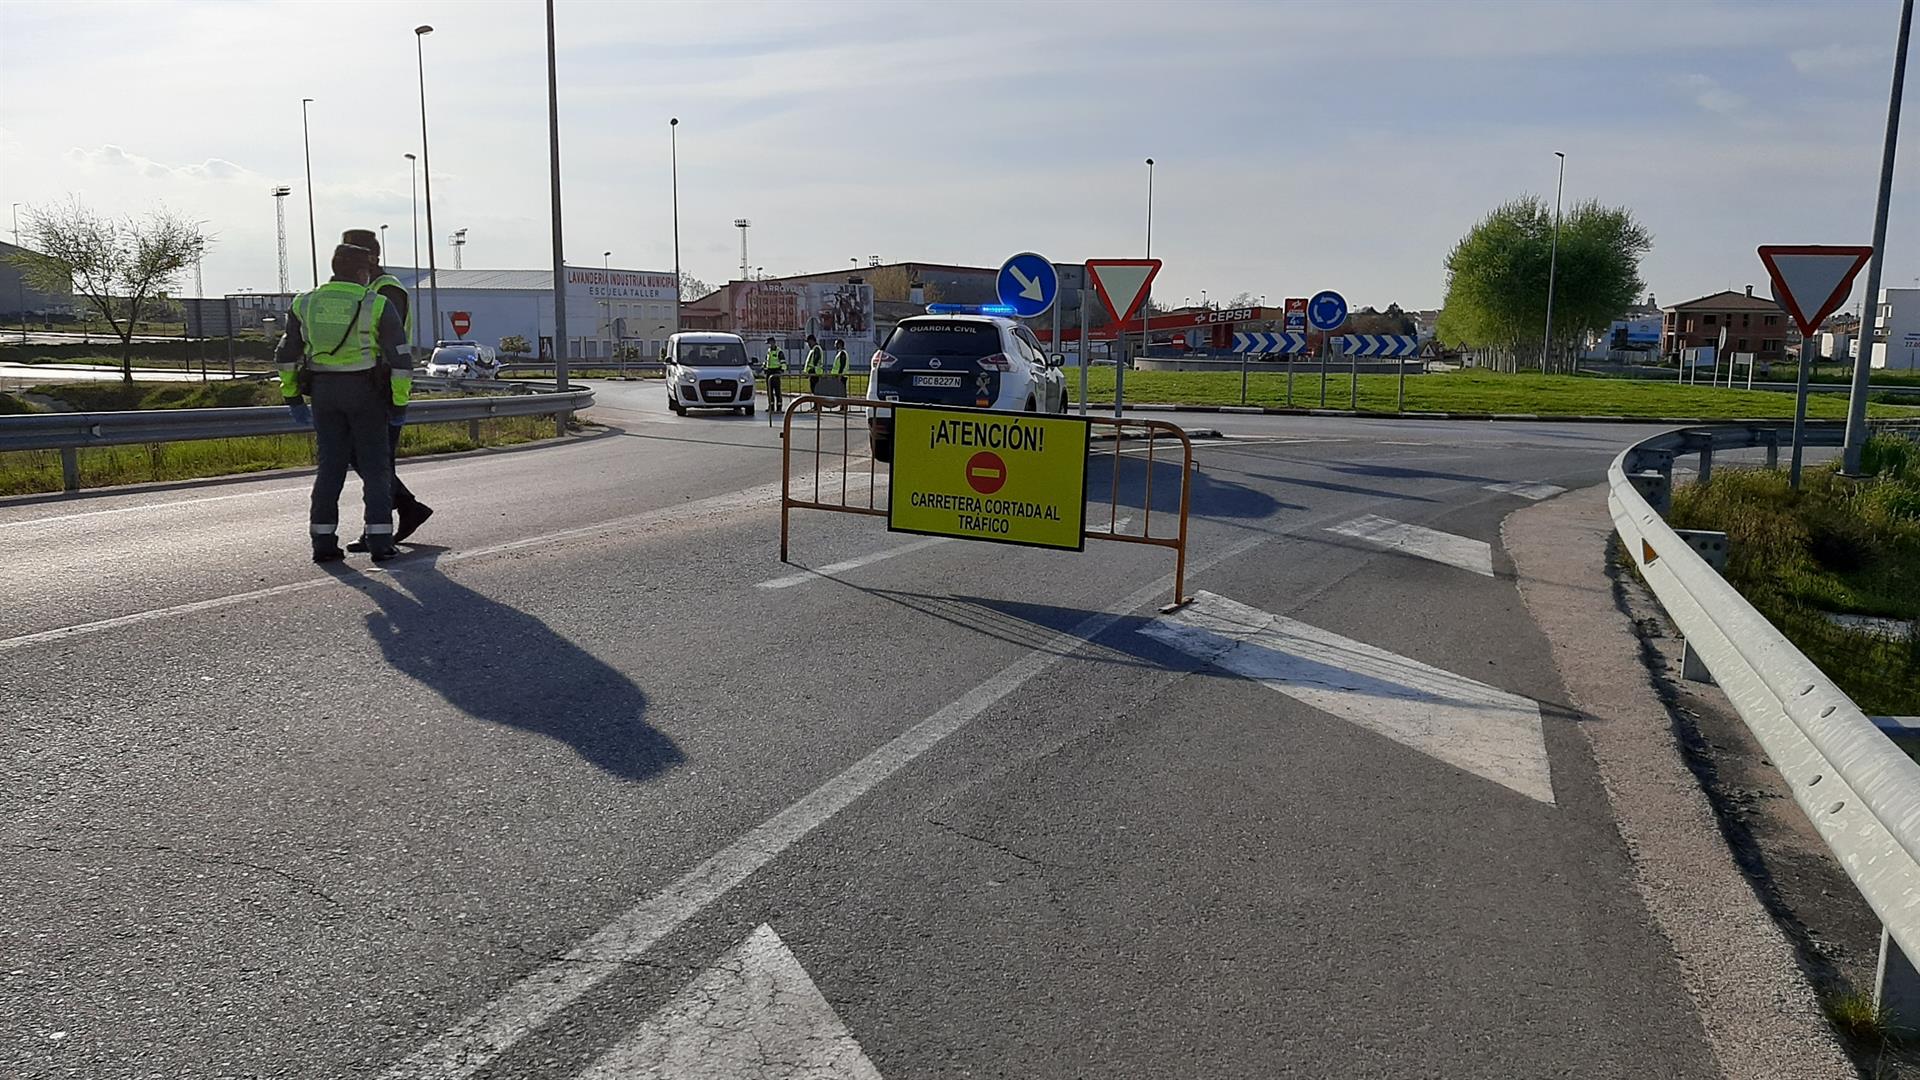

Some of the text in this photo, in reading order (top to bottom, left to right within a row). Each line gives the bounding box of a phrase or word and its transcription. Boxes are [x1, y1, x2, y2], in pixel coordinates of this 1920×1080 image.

[610, 274, 646, 287] INDUSTRIAL
[589, 287, 660, 298] ESCUELA TALLER
[1208, 309, 1252, 323] CEPSA
[910, 325, 977, 334] GUARDIA CIVIL
[930, 418, 1044, 452] ¡ATENCIÓN!
[911, 491, 1061, 521] CARRETERA CORTADA AL
